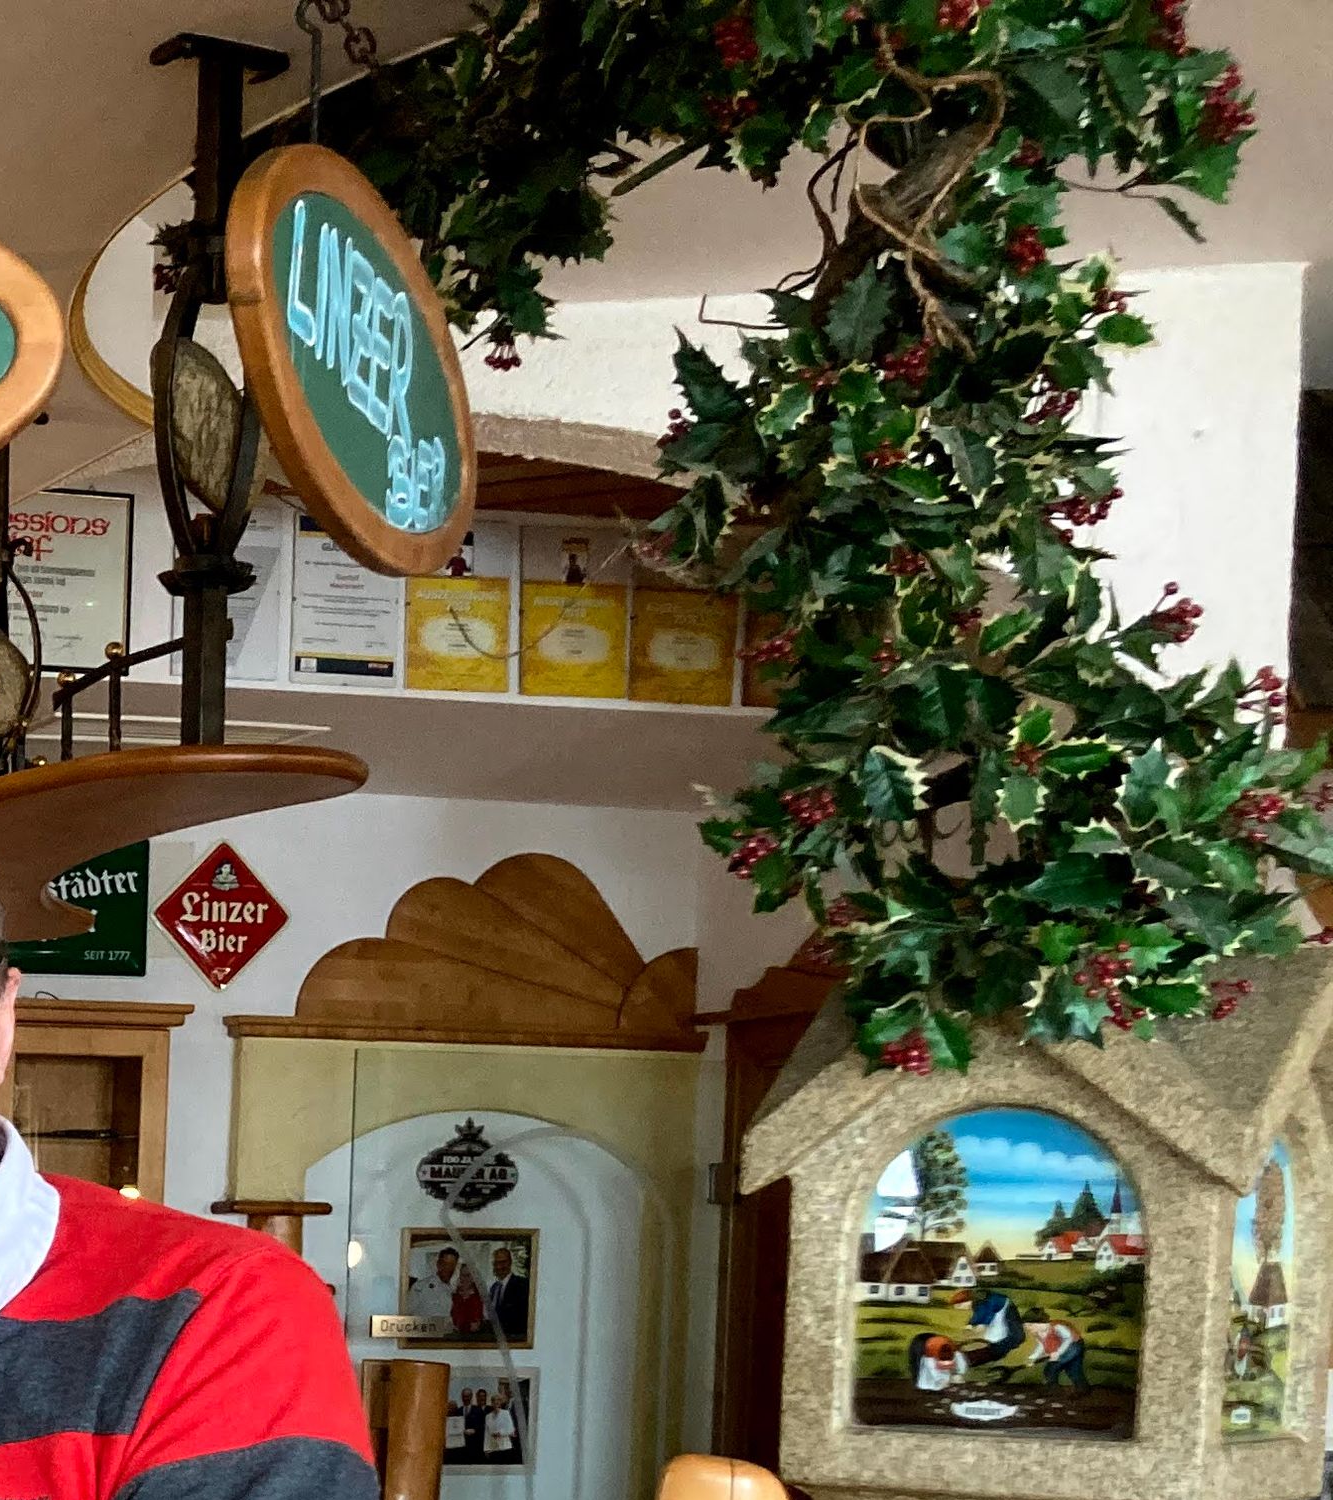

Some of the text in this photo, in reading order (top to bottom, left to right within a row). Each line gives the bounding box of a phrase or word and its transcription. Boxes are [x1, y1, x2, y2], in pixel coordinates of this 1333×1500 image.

[286, 199, 413, 460] LINZER
[9, 511, 111, 536] ssions
[180, 892, 270, 924] Linzer
[199, 927, 248, 953] Bier
[84, 950, 132, 961] SEIT 1777
[380, 1319, 438, 1332] Drucken
